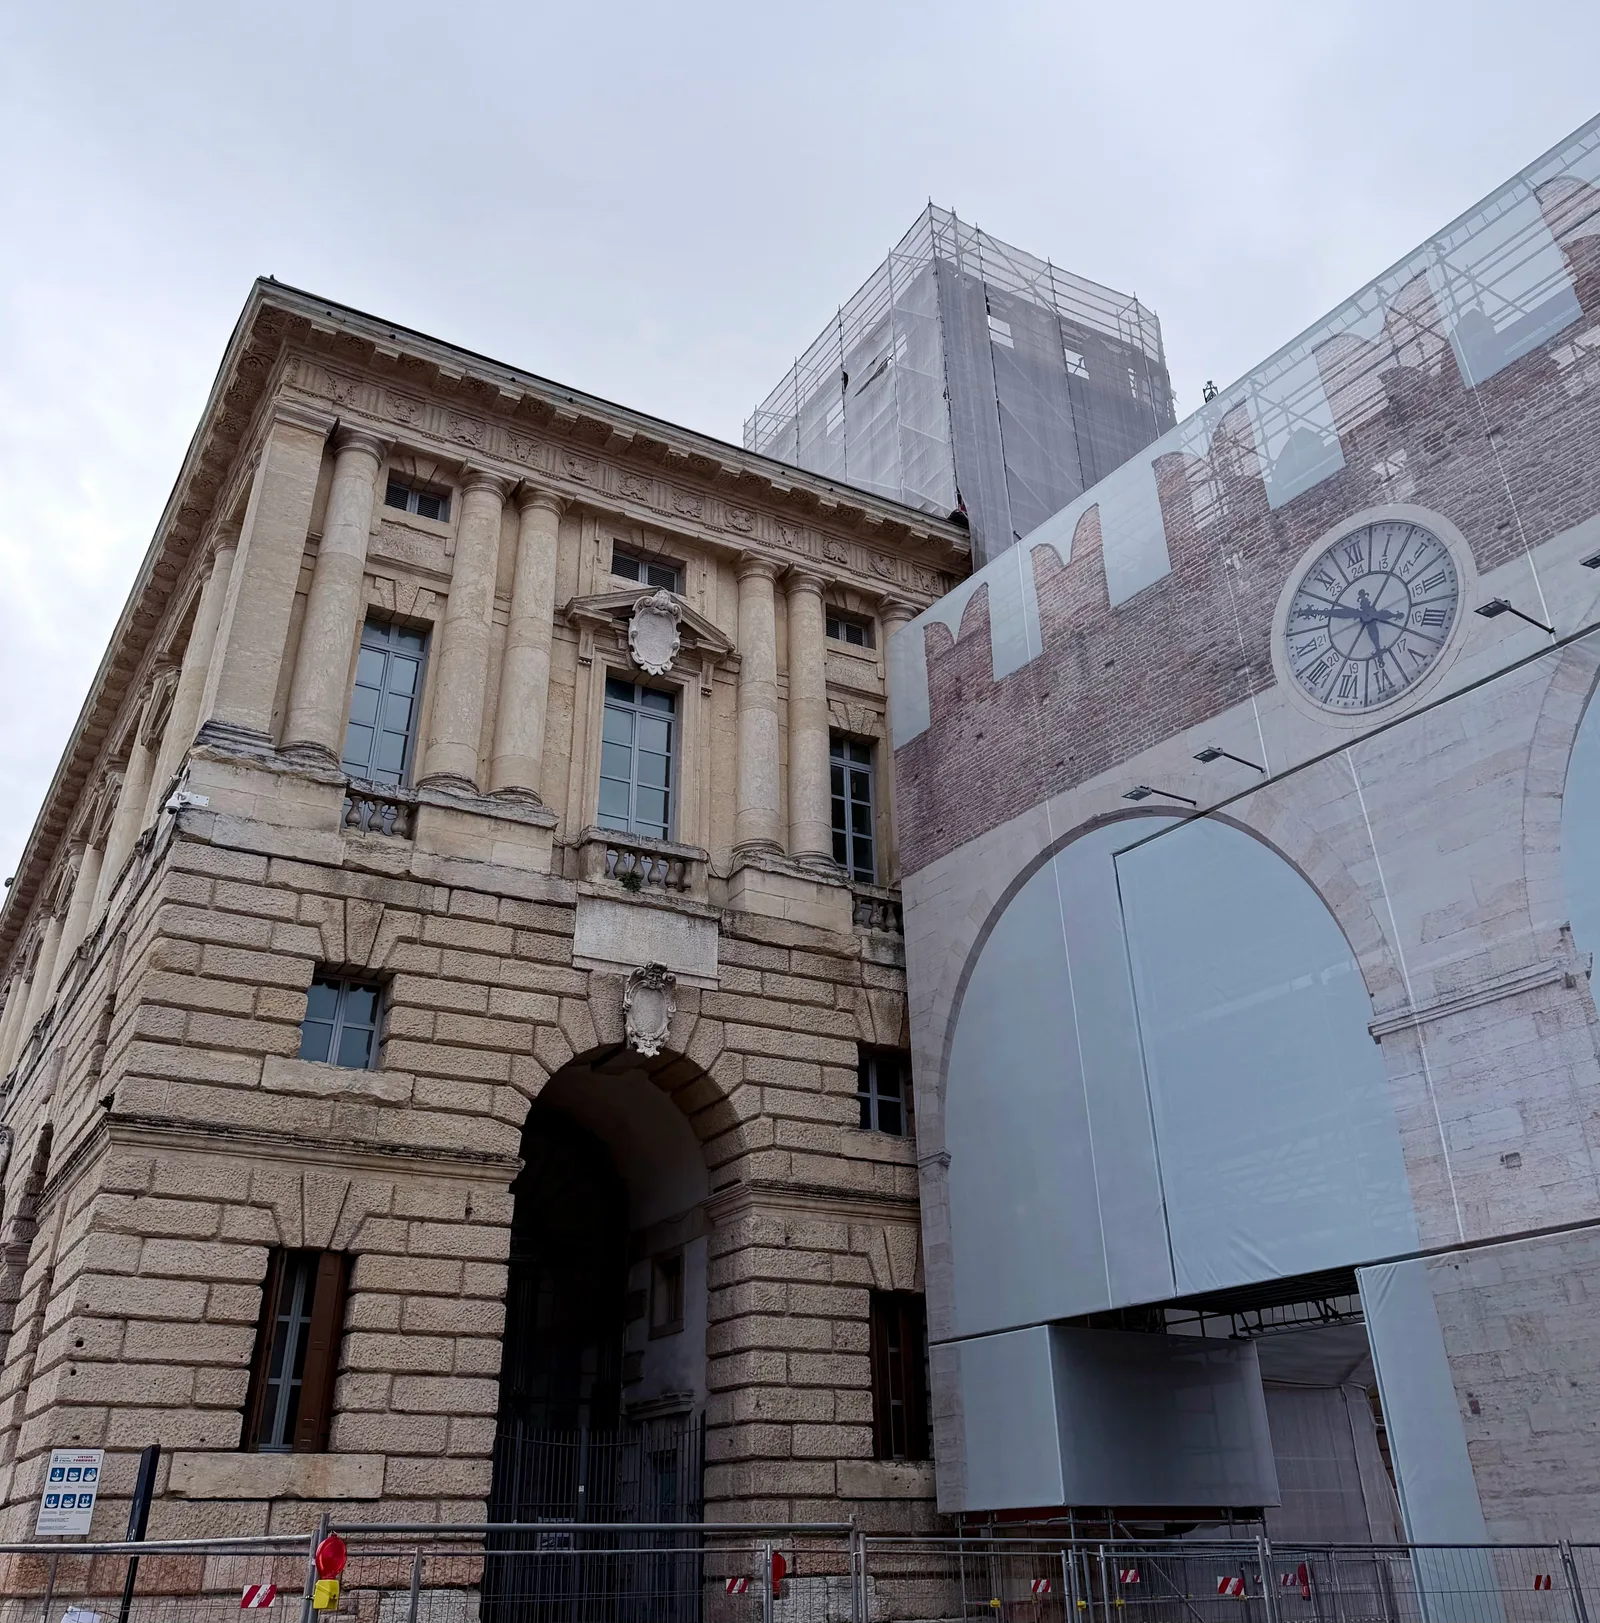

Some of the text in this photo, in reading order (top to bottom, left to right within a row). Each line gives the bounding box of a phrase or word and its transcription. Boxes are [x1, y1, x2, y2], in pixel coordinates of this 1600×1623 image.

[1342, 540, 1364, 568] XII
[1381, 534, 1393, 558] I
[1351, 564, 1365, 579] 24
[1378, 558, 1389, 571] 13
[1398, 563, 1410, 577] 14
[1313, 568, 1336, 592] XI
[1421, 568, 1447, 594] III
[1329, 582, 1343, 597] 23
[1411, 583, 1423, 598] 15
[1411, 610, 1423, 625] 16
[1420, 607, 1448, 628] IIII
[1296, 636, 1318, 660] IX
[1317, 633, 1327, 647] 21
[1396, 638, 1407, 654] 17
[1326, 652, 1340, 667] 20
[1407, 648, 1429, 668] V
[1349, 662, 1359, 675] 19
[1337, 675, 1358, 700] VII
[1373, 668, 1396, 695] VI
